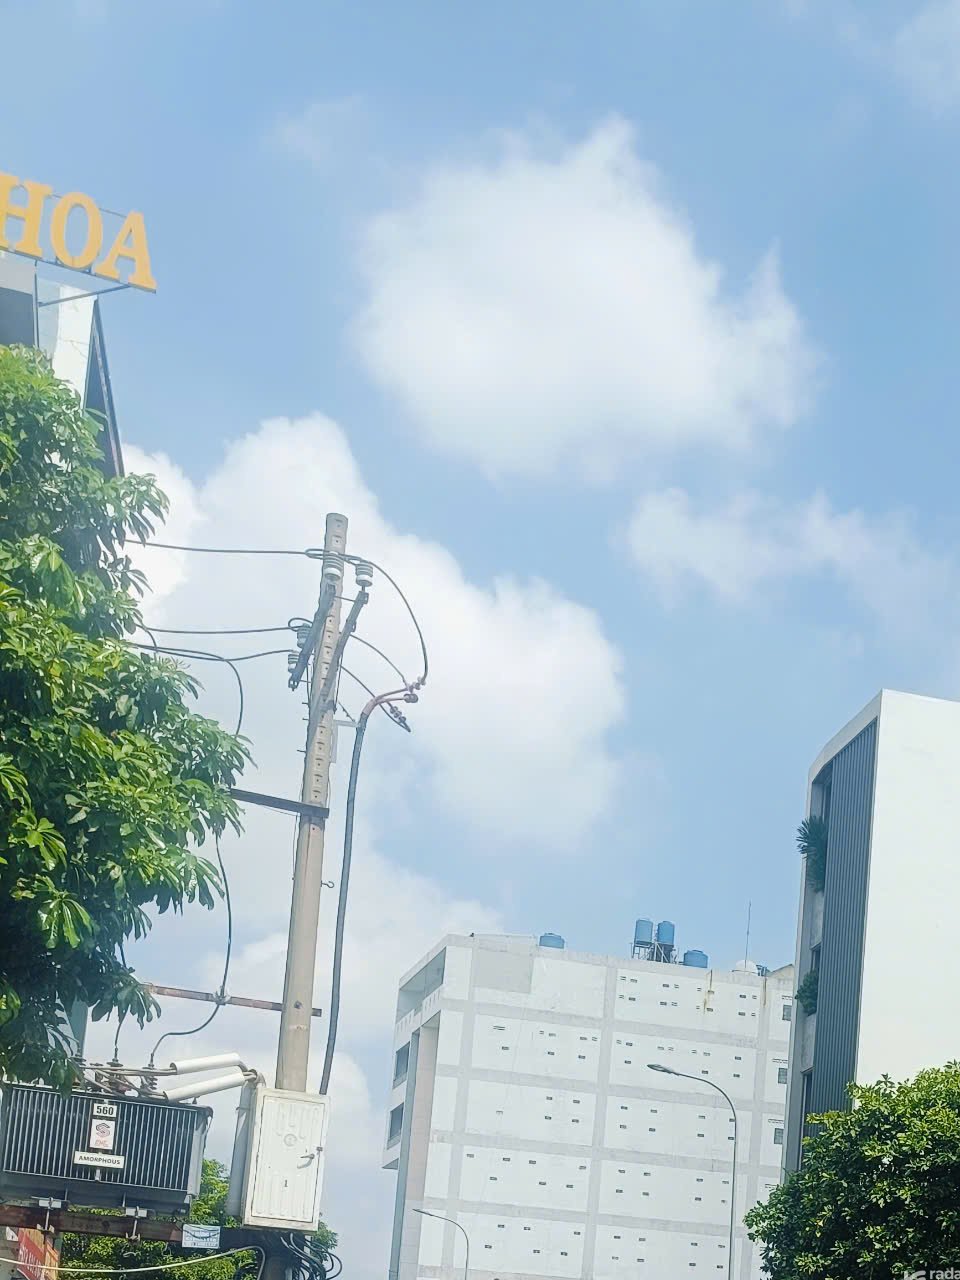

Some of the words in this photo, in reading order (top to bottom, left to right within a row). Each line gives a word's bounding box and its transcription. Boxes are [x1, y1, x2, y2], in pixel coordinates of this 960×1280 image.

[0, 171, 156, 290] HOA
[96, 1105, 114, 1116] 560
[78, 1155, 121, 1165] AMORPHOUS
